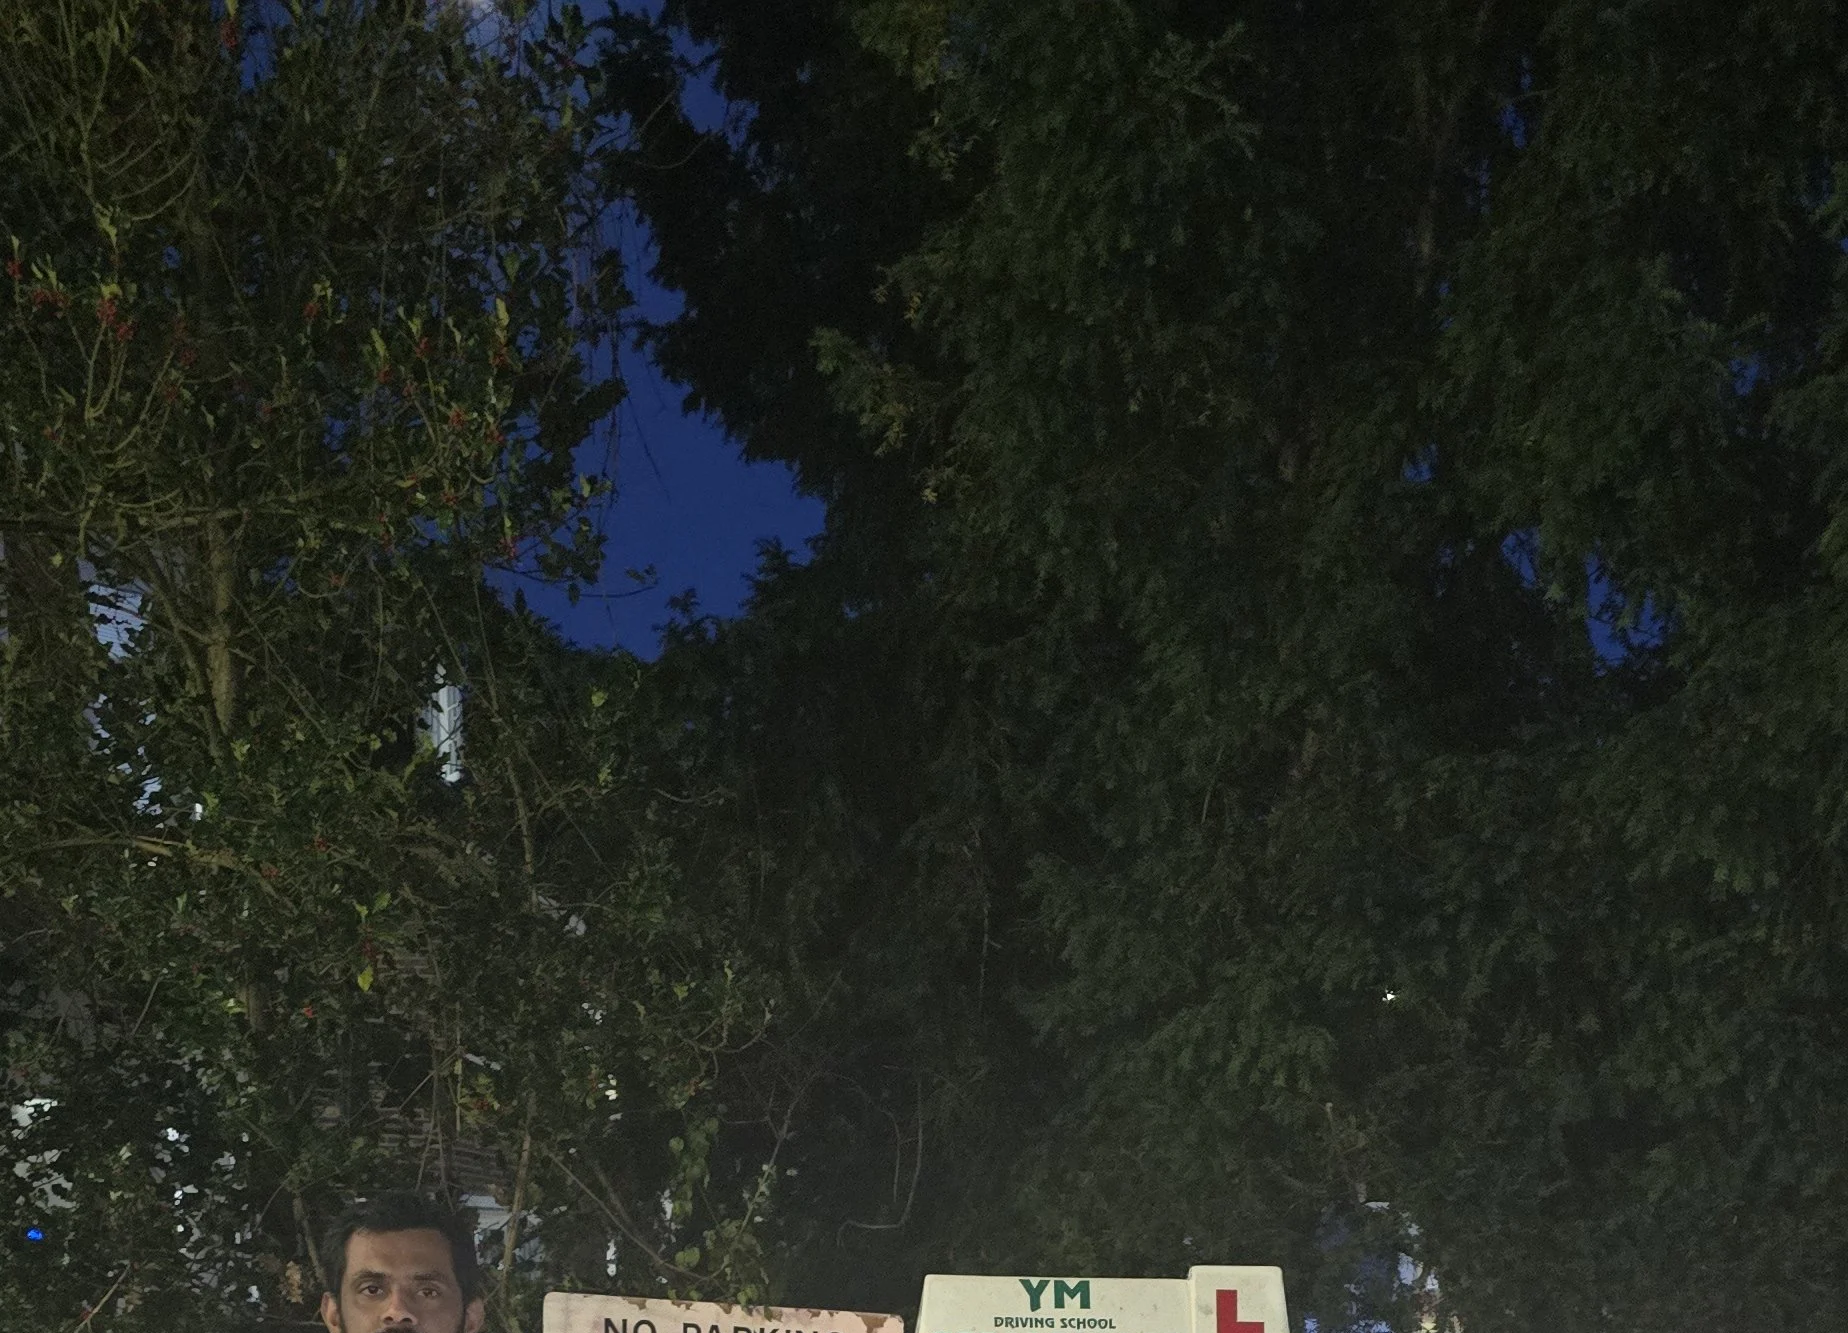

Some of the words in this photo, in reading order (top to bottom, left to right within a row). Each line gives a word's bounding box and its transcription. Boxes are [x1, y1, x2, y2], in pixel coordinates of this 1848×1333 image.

[1019, 1279, 1091, 1312] YM
[994, 1316, 1055, 1329] DRIVING
[1060, 1317, 1117, 1330] SCHOOL
